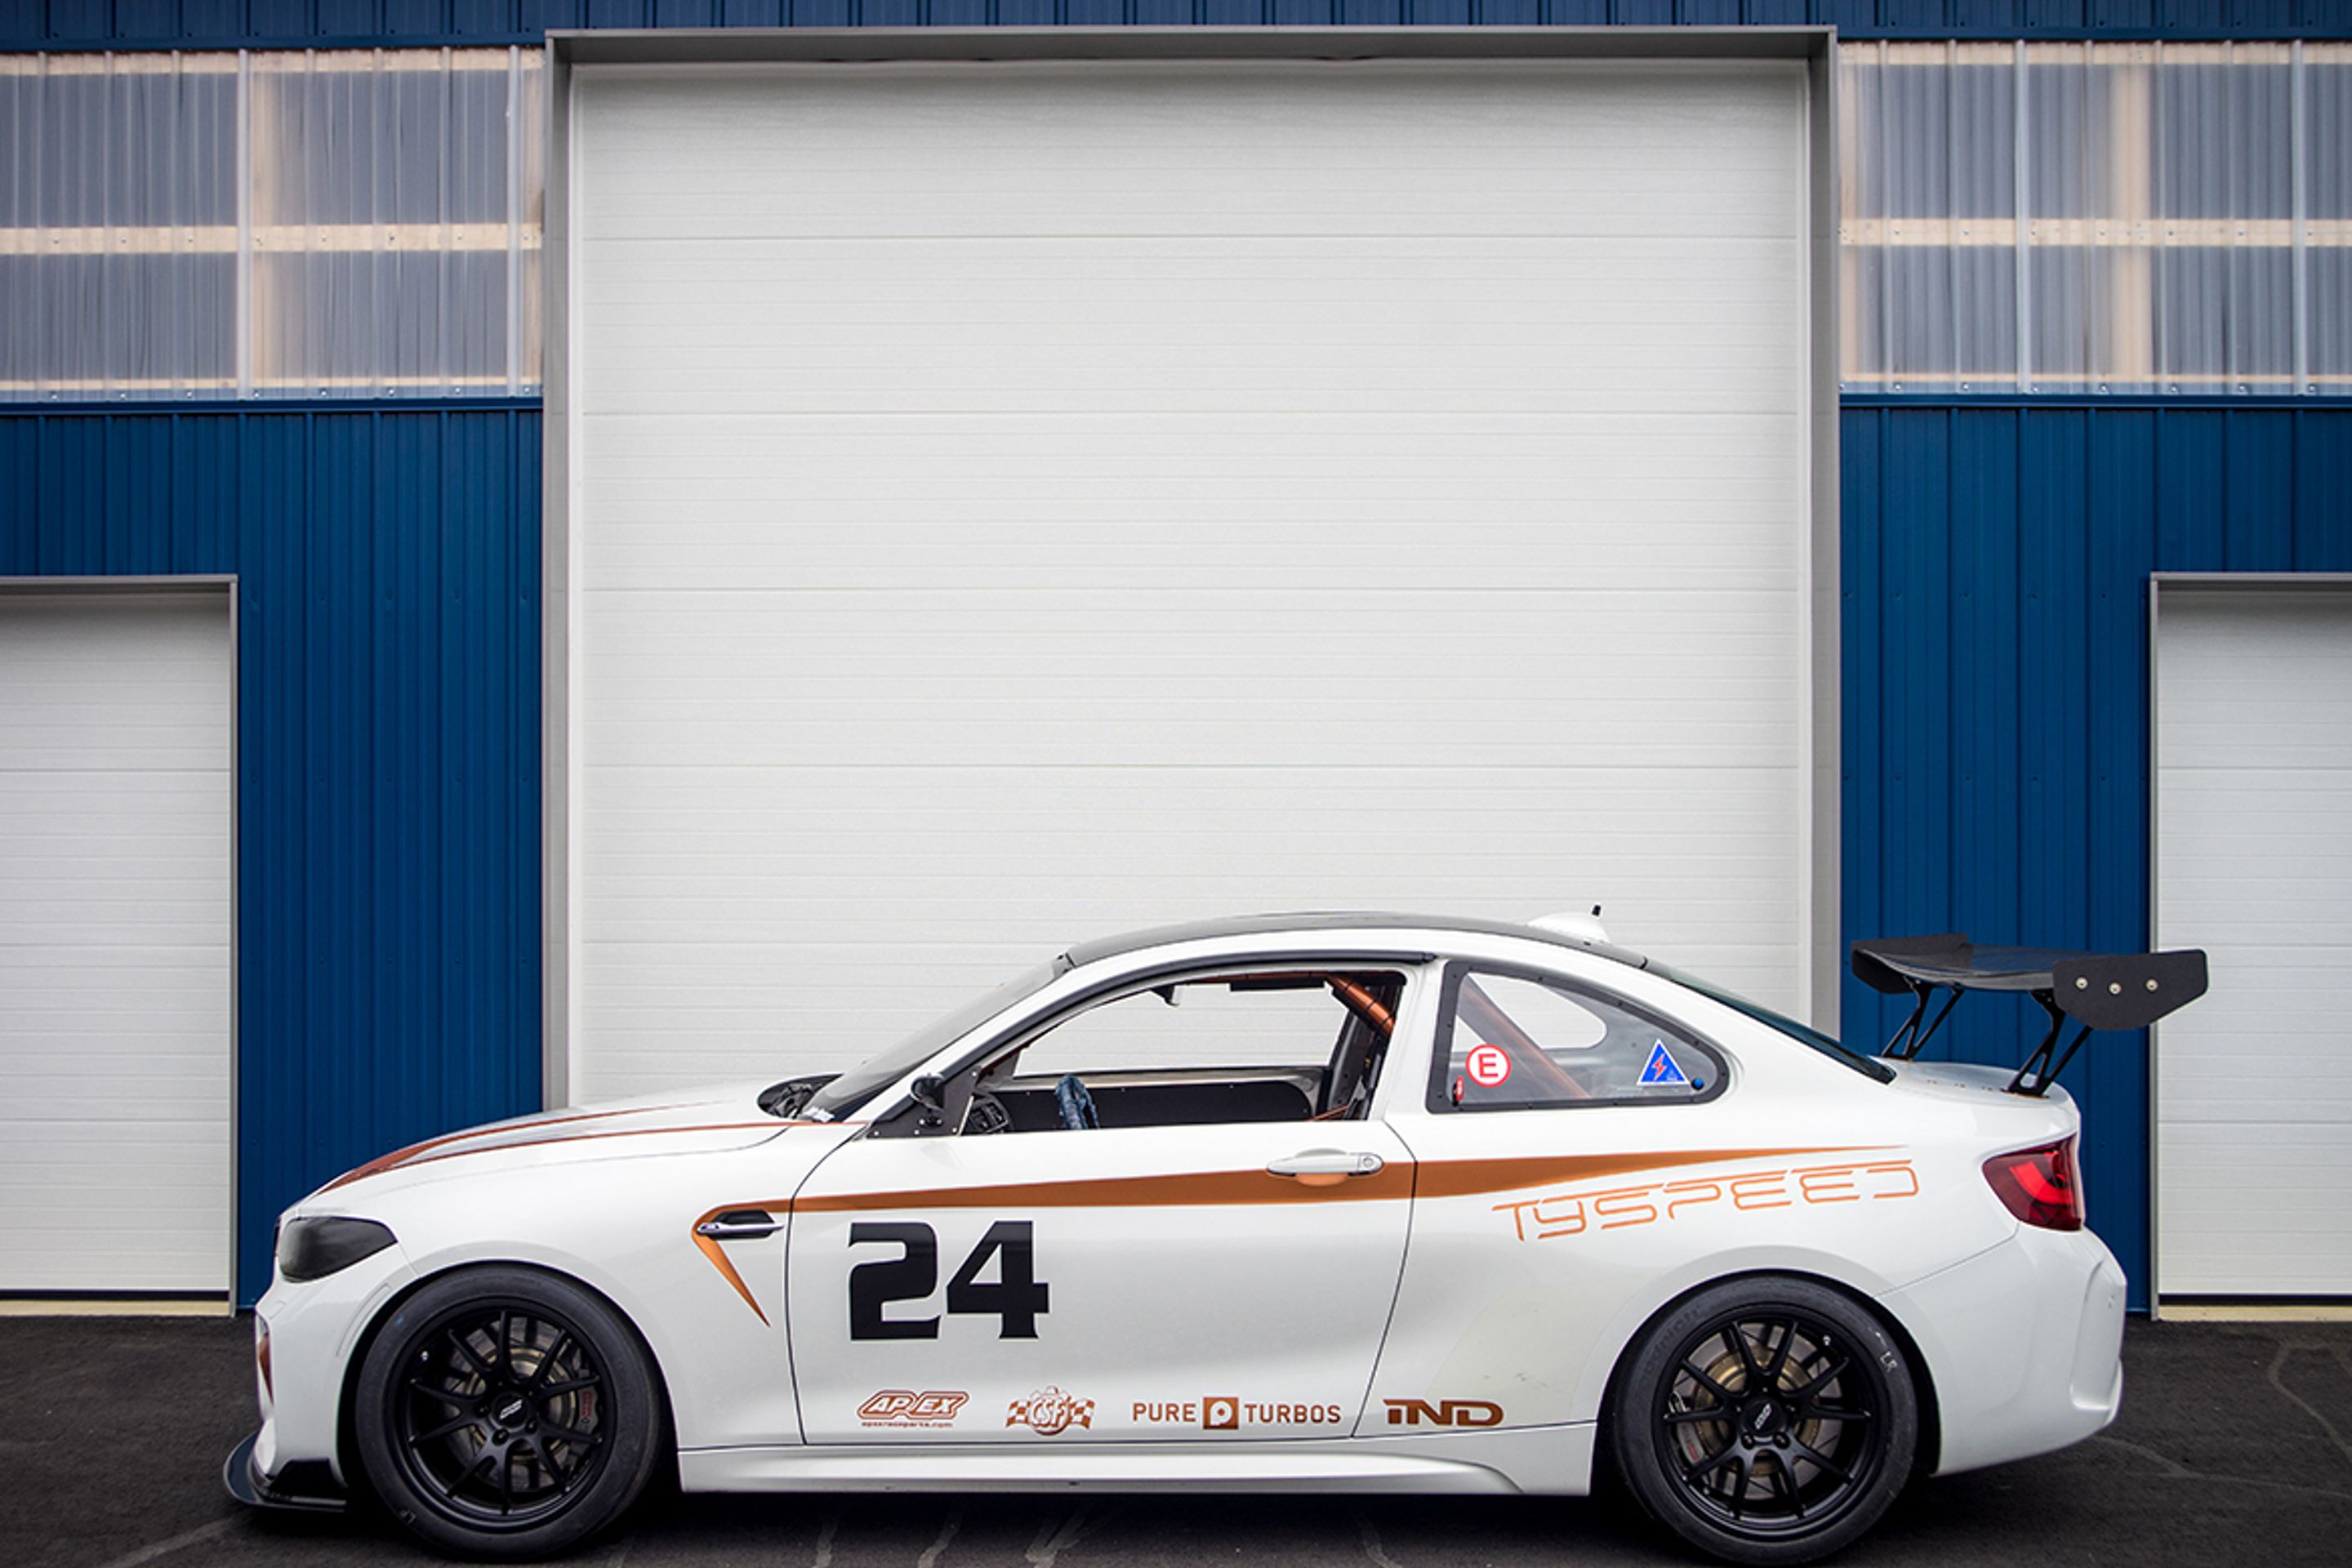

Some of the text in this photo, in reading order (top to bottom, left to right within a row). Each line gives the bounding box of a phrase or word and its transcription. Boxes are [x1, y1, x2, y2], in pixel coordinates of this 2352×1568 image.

[1478, 1054, 1499, 1077] E
[848, 1220, 1049, 1340] 24
[862, 1394, 964, 1415] APEX
[1133, 1403, 1196, 1422] PURE
[1245, 1404, 1341, 1423] TURBOS
